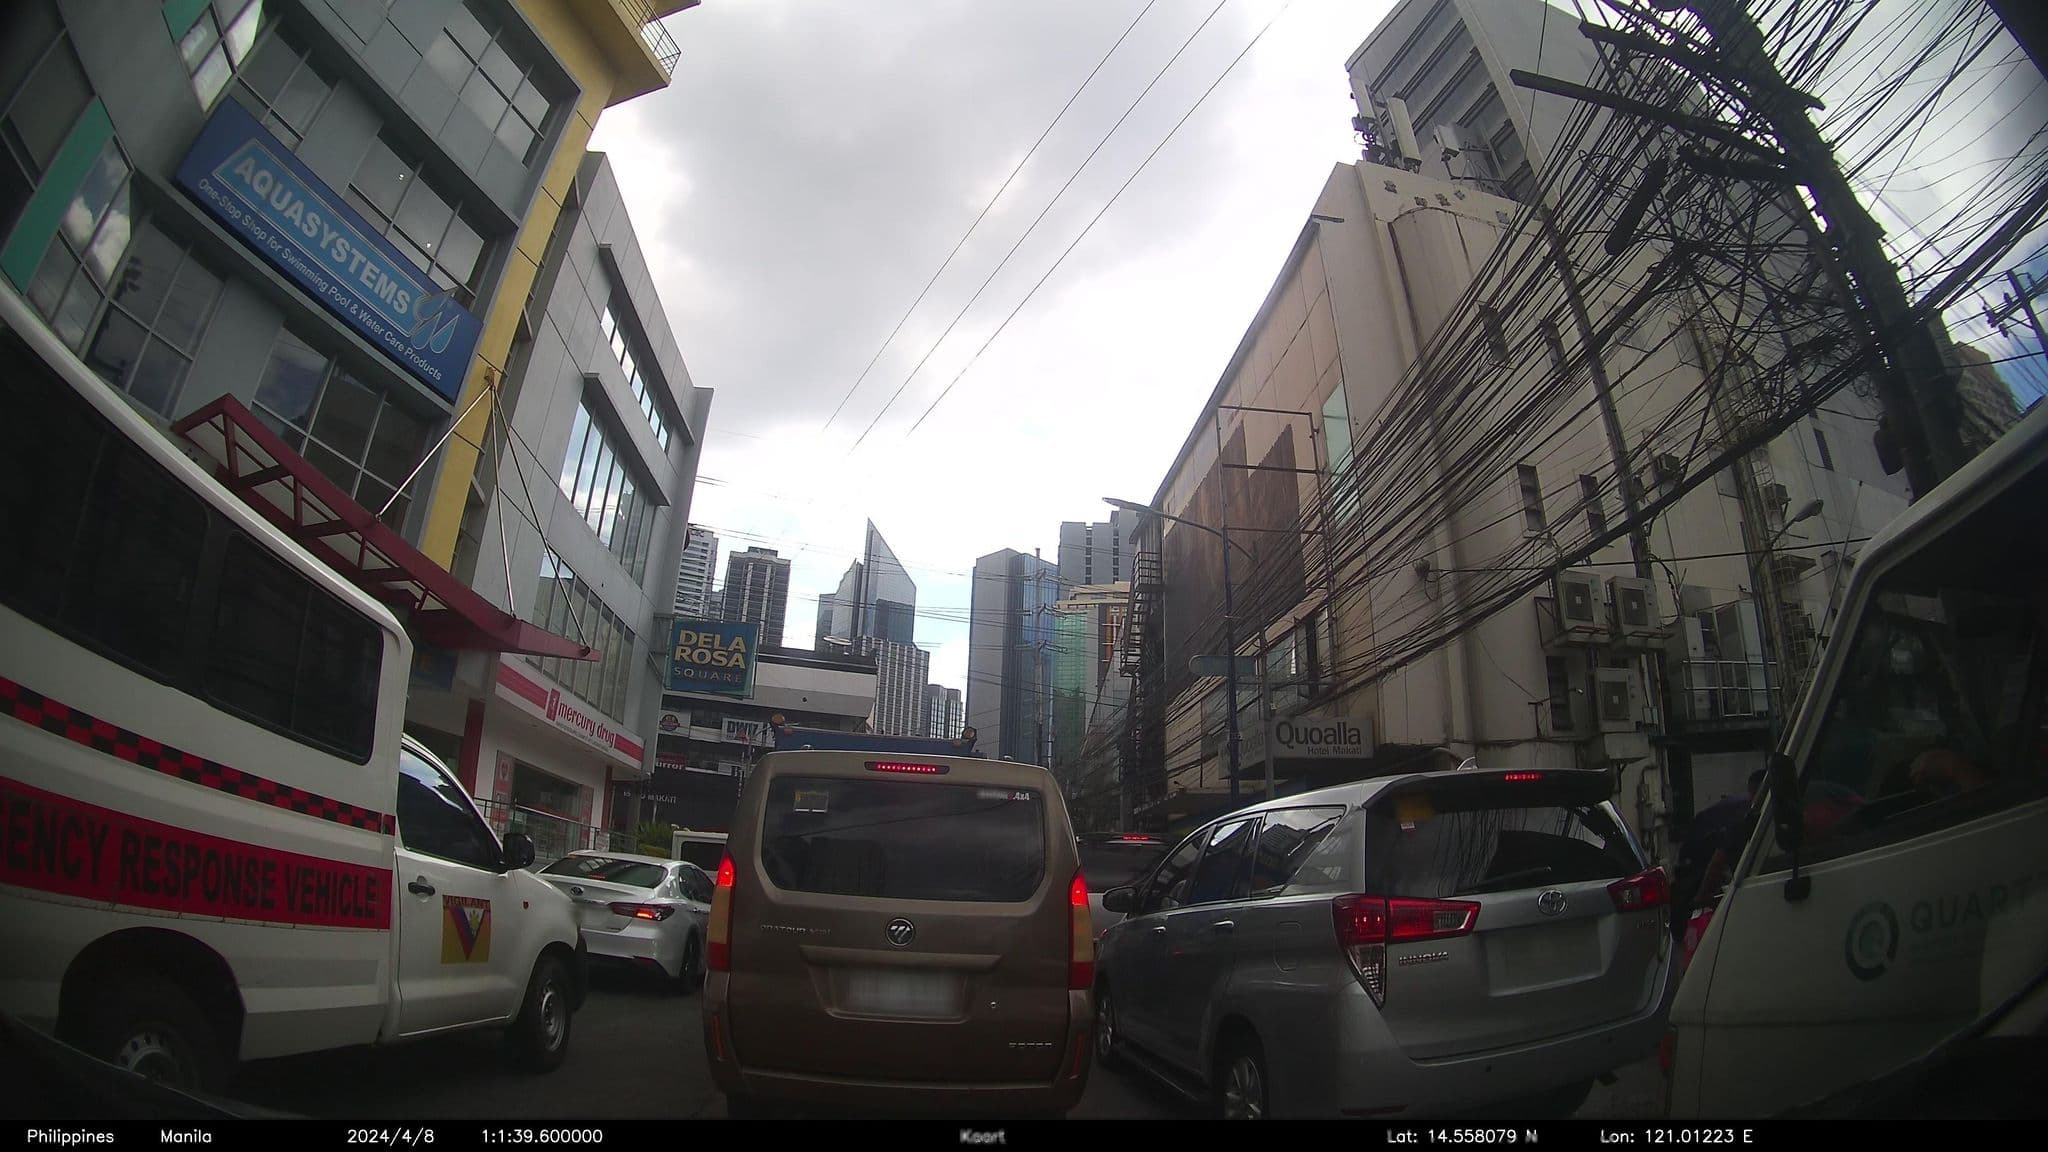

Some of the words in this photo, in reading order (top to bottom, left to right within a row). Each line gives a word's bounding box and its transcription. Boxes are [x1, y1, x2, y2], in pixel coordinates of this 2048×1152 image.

[233, 156, 411, 316] AQUASYSTEMS
[198, 178, 242, 222] One-Stop
[241, 211, 267, 242] Shop
[267, 235, 283, 252] for
[281, 246, 328, 293] Swimming
[327, 285, 351, 308] Pool
[350, 300, 358, 315] &
[358, 306, 385, 335] Water
[384, 330, 406, 352] Care
[404, 345, 443, 381] Products
[679, 629, 747, 653] DELA
[674, 645, 746, 670] ROSA
[674, 666, 742, 684] SQUARE
[557, 701, 596, 737] mercury
[596, 722, 615, 748] drug
[1275, 721, 1362, 750] Quoalla
[1307, 745, 1330, 756] Hotel
[1332, 746, 1362, 756] Makati
[120, 829, 276, 910] RESPONSE
[285, 863, 378, 919] VEHICLE
